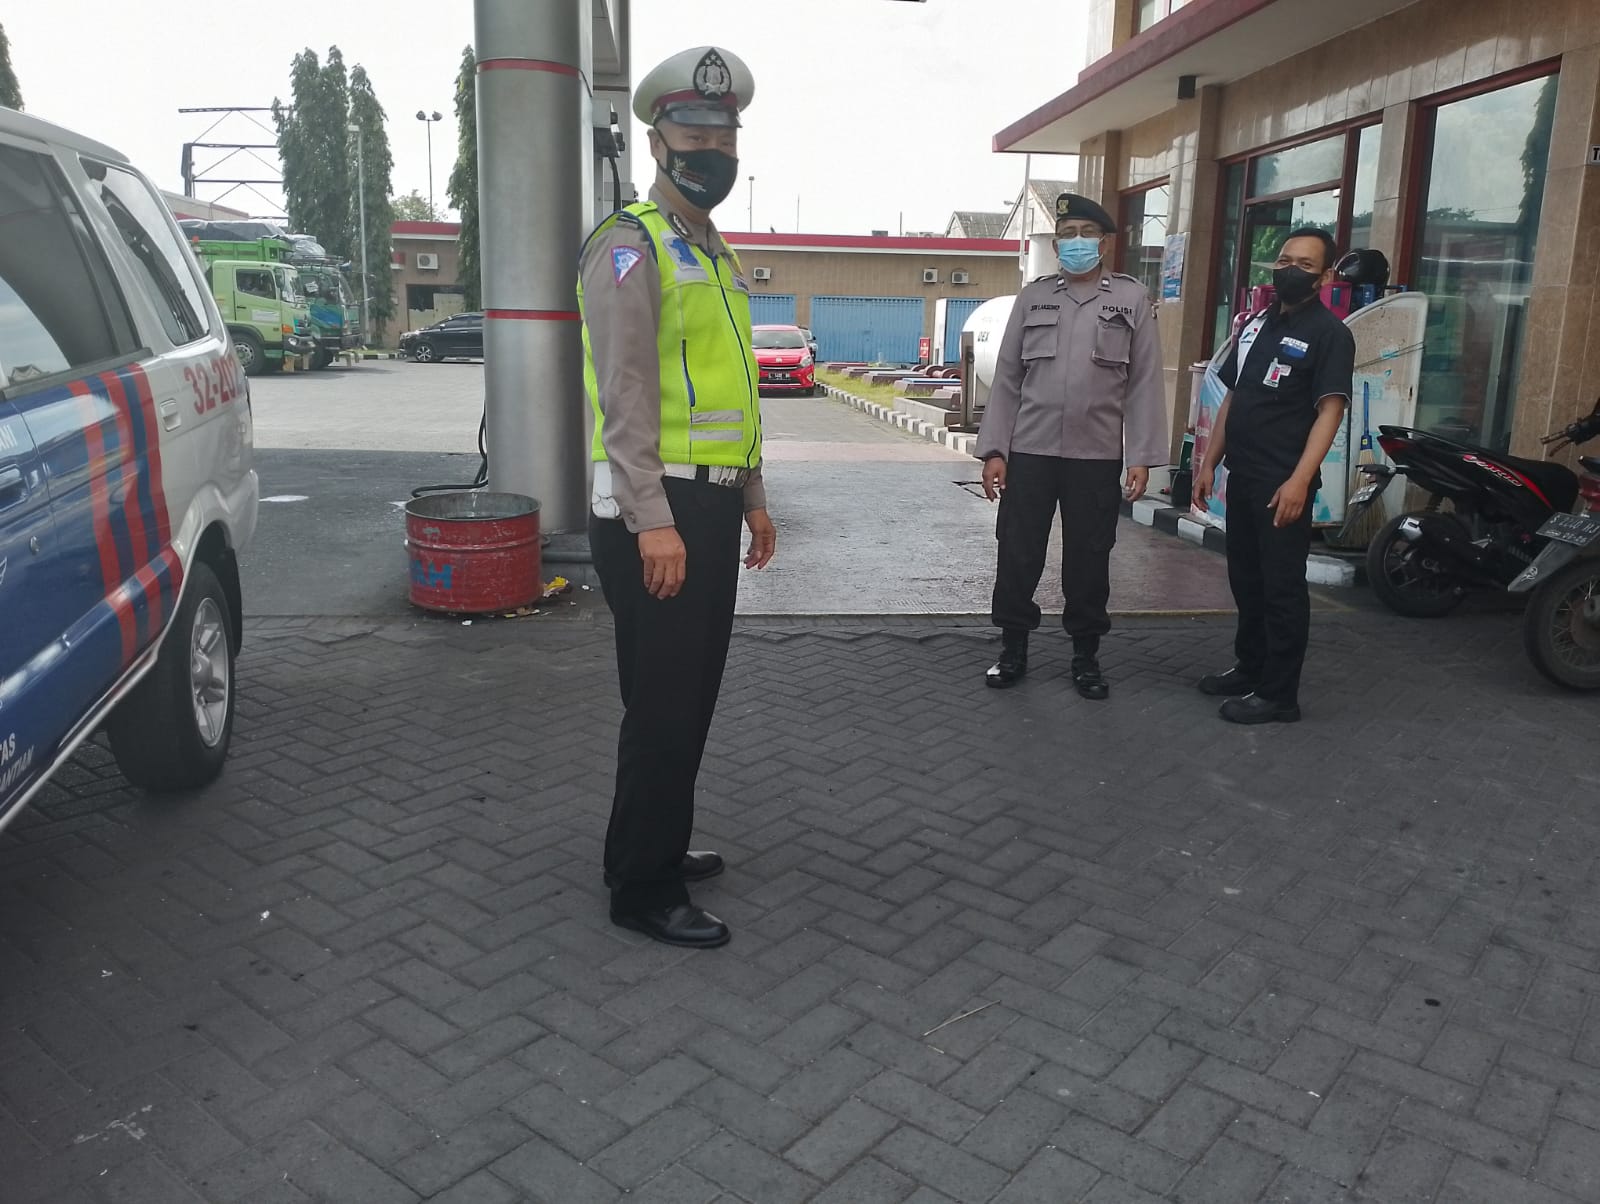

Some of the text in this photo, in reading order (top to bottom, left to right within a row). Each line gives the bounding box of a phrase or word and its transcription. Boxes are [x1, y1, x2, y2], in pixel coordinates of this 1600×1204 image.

[1593, 147, 1600, 161] T
[1102, 305, 1132, 315] POLISI
[0, 733, 15, 767] AS
